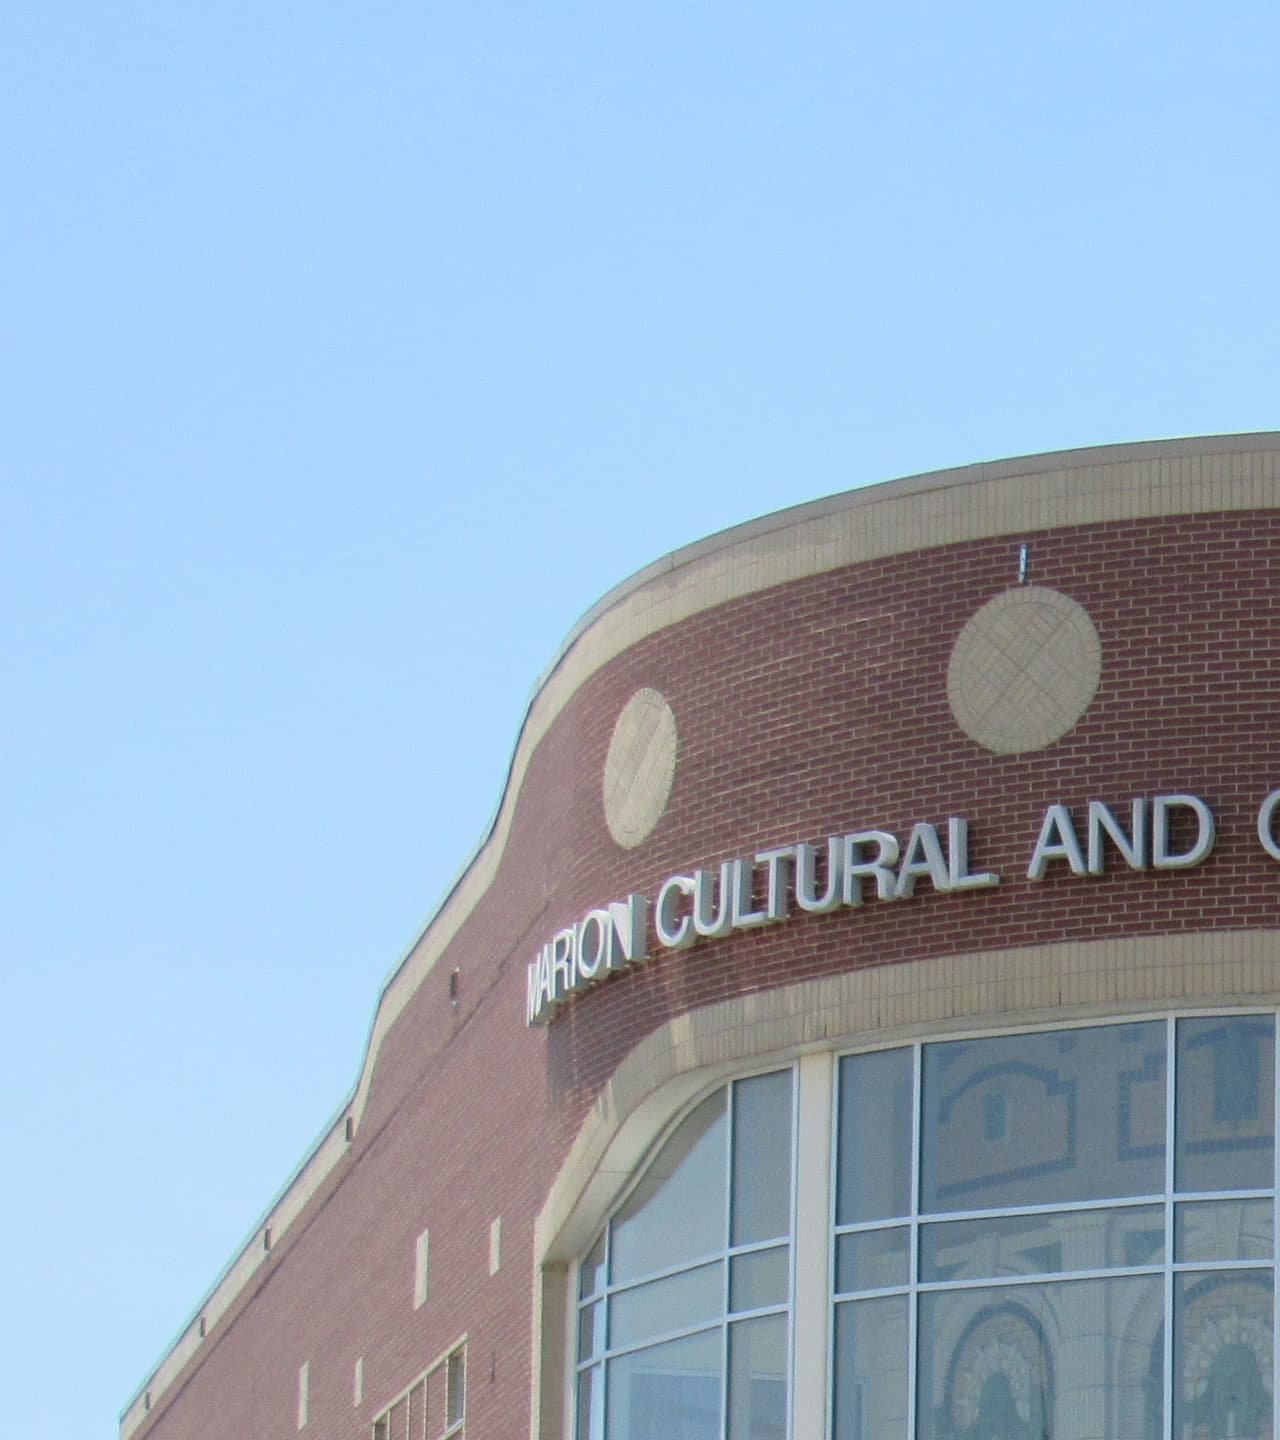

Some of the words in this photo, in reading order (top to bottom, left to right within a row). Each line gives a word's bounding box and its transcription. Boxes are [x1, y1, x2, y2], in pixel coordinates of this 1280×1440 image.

[526, 894, 646, 1026] MARION
[655, 816, 998, 950] CULTURAL
[1027, 794, 1216, 881] AND
